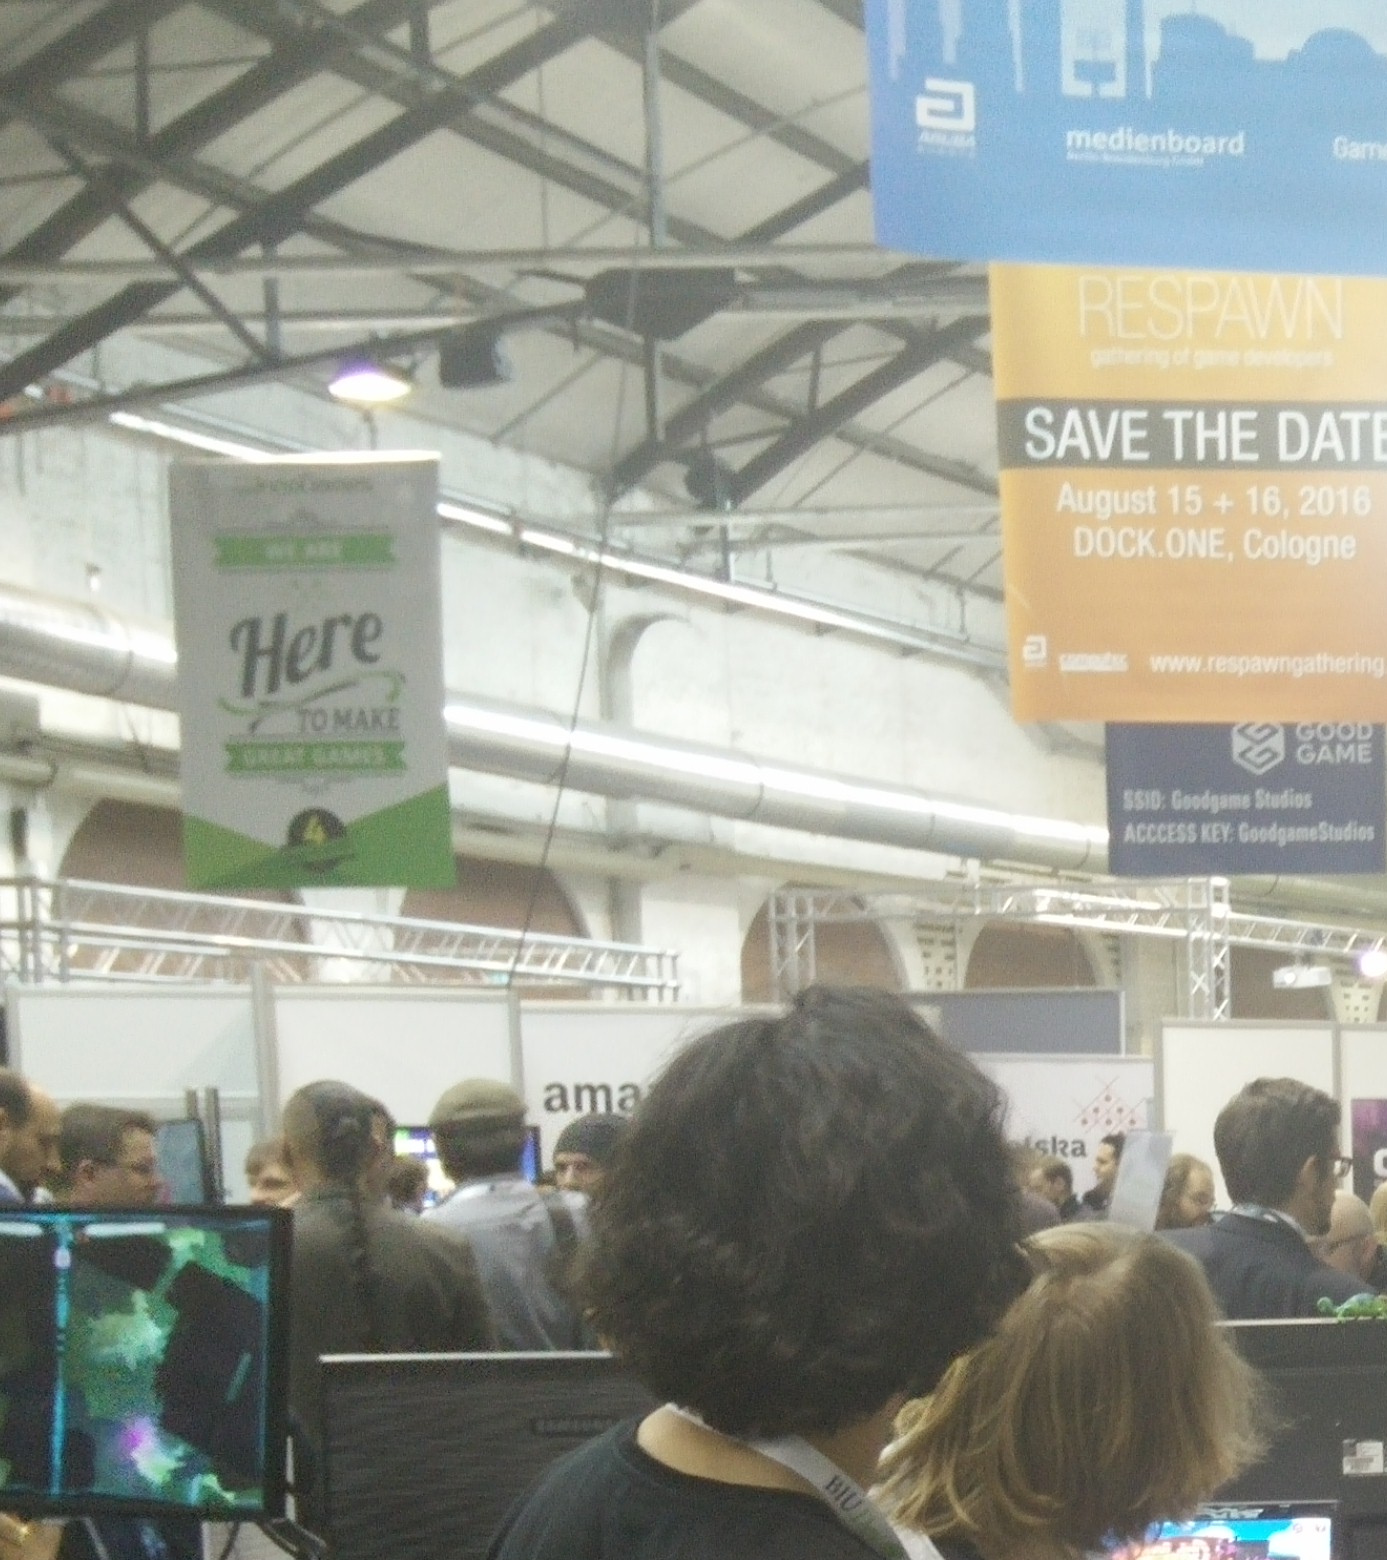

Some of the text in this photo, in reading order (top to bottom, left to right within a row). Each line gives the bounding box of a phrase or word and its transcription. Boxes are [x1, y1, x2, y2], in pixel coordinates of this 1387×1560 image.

[1066, 127, 1246, 157] medienboard
[1078, 273, 1344, 341] RESPAWN
[1025, 407, 1150, 461] SAVE
[1163, 410, 1259, 462] THE
[1057, 481, 1372, 520] August 15 + 16, 2016
[1073, 526, 1357, 566] DOCK.ONE, Cologne
[228, 612, 384, 698] Here
[297, 708, 400, 732] TO MAKE
[1295, 723, 1373, 742] GOOD
[1295, 744, 1373, 764] GAME
[1123, 788, 1313, 814] SSID: Goodgame Studios
[1123, 820, 1375, 847] ACCCESS KEY: GoodgameStudios
